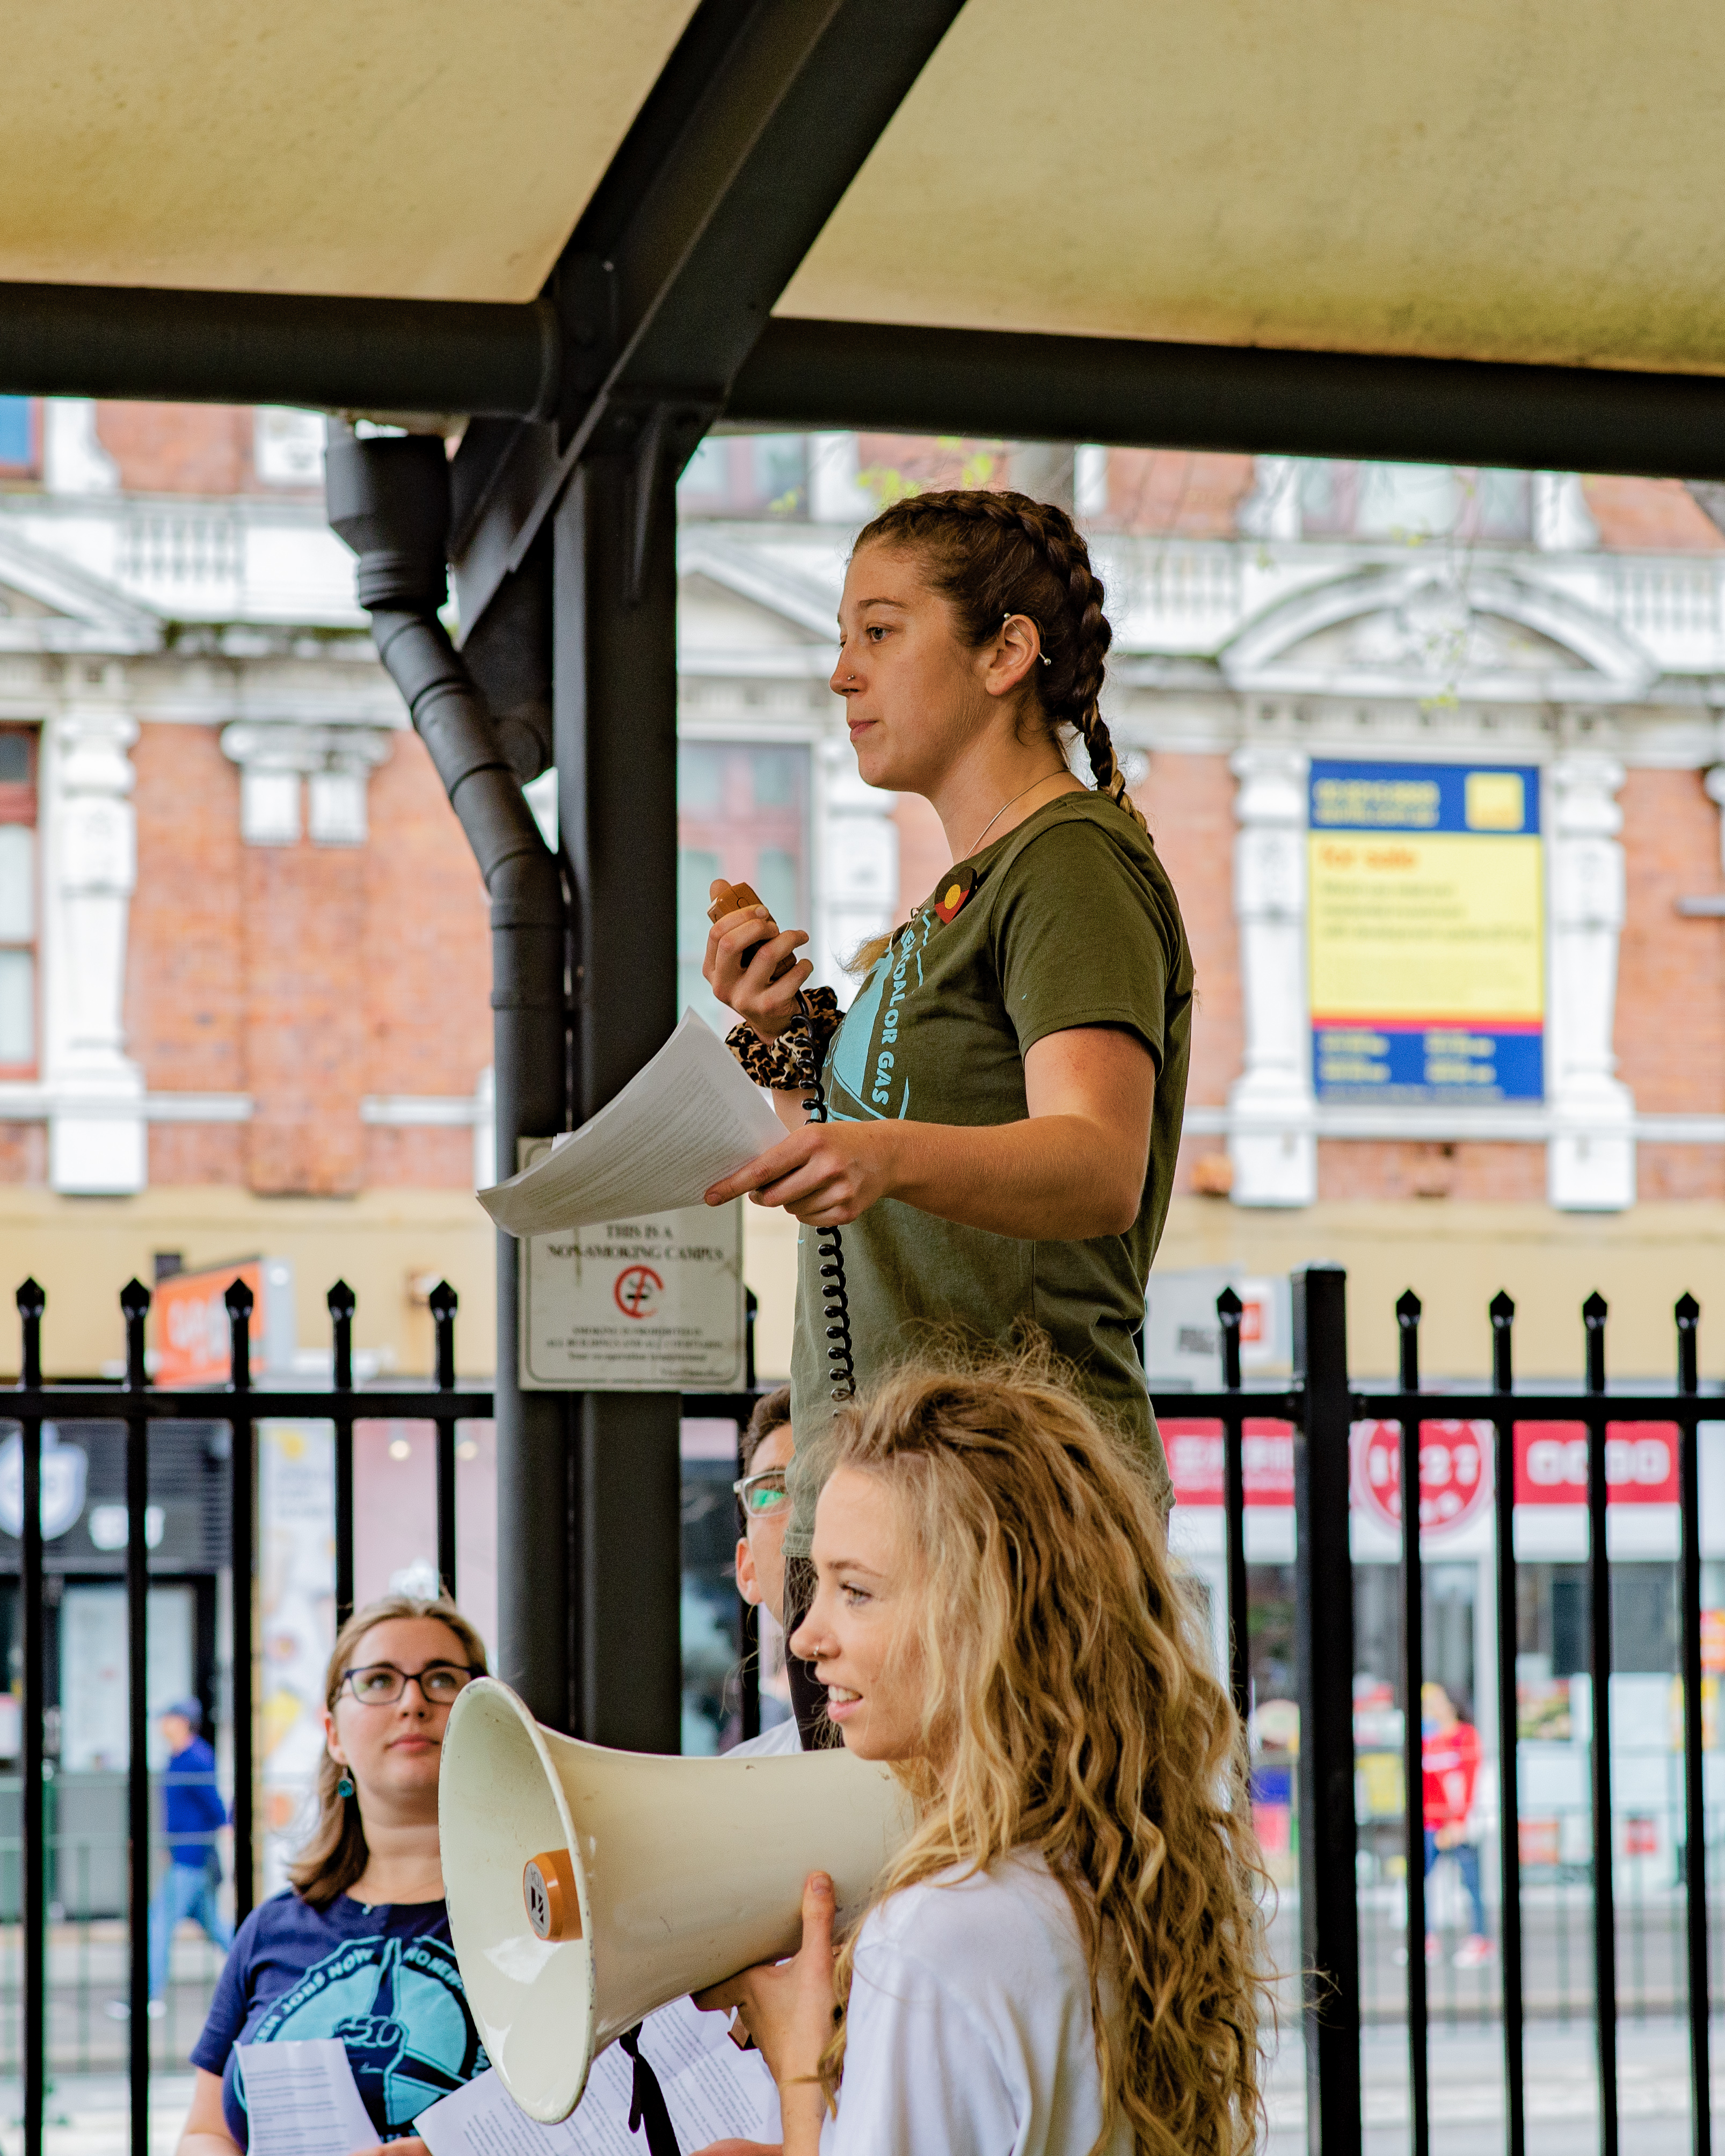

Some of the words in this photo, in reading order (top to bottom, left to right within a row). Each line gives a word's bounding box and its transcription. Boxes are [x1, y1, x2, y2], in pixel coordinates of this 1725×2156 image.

[889, 953, 911, 1007] COAL
[881, 1008, 899, 1045] OR
[871, 1051, 895, 1105] GAS
[327, 1947, 375, 1980] NOW
